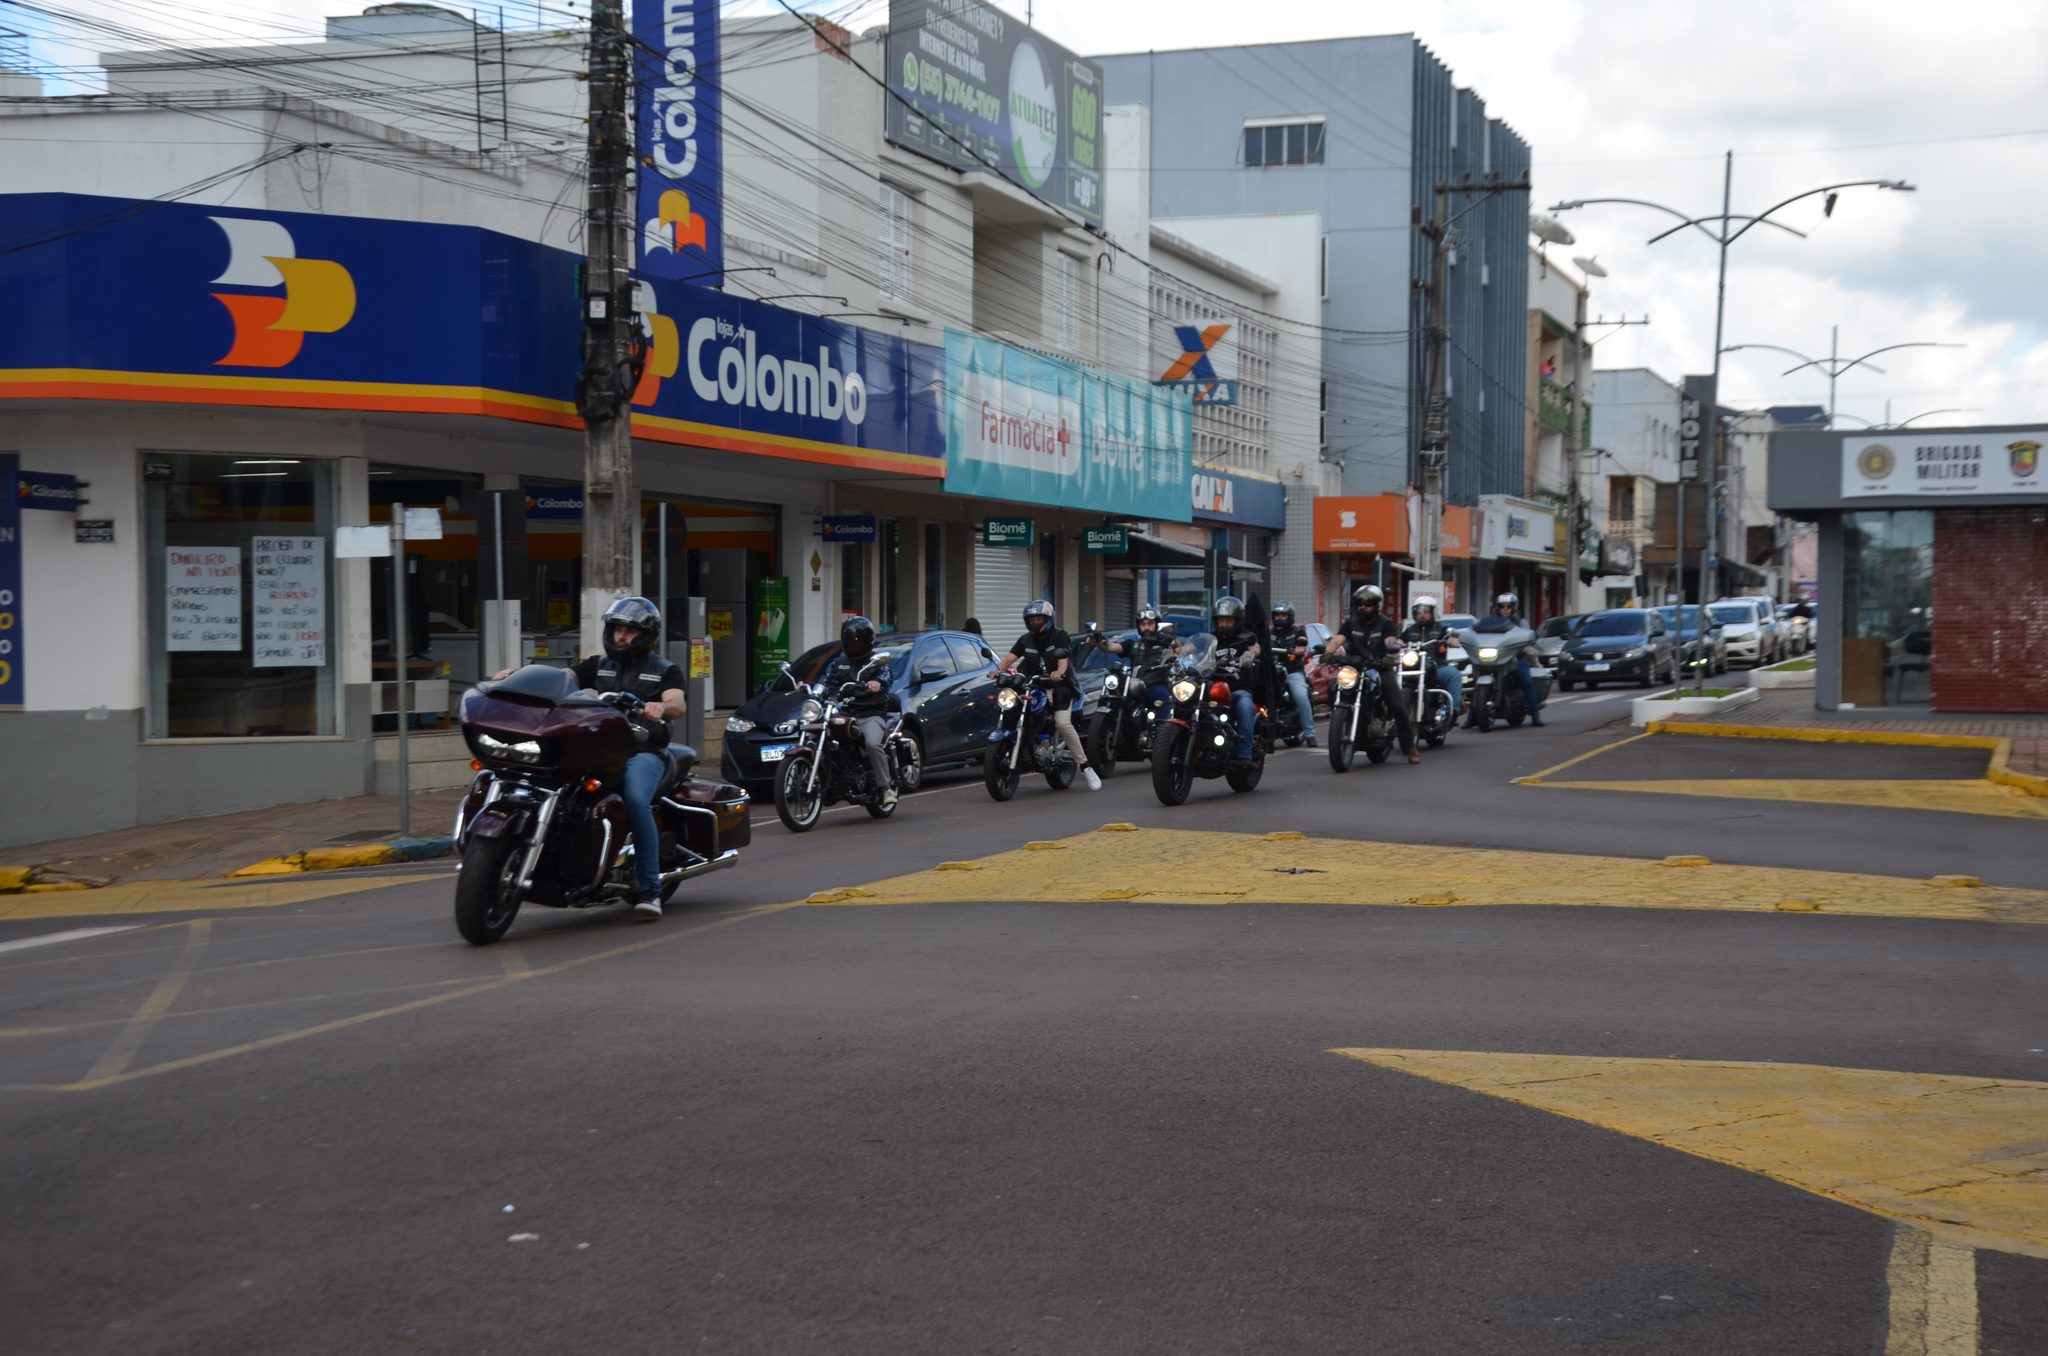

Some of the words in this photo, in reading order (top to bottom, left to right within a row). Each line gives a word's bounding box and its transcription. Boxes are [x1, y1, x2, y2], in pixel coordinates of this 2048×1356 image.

[919, 28, 947, 61] INTERNET
[947, 44, 956, 67] DE
[955, 49, 969, 74] ALTO
[1010, 91, 1057, 136] ATUATEC
[1072, 84, 1096, 141] 600
[717, 316, 734, 337] lojas
[687, 316, 866, 425] Colombo
[1916, 445, 1982, 461] BRIGADA
[1916, 463, 1981, 479] MILITAR
[537, 497, 584, 509] Colombo
[835, 524, 874, 534] Colombo
